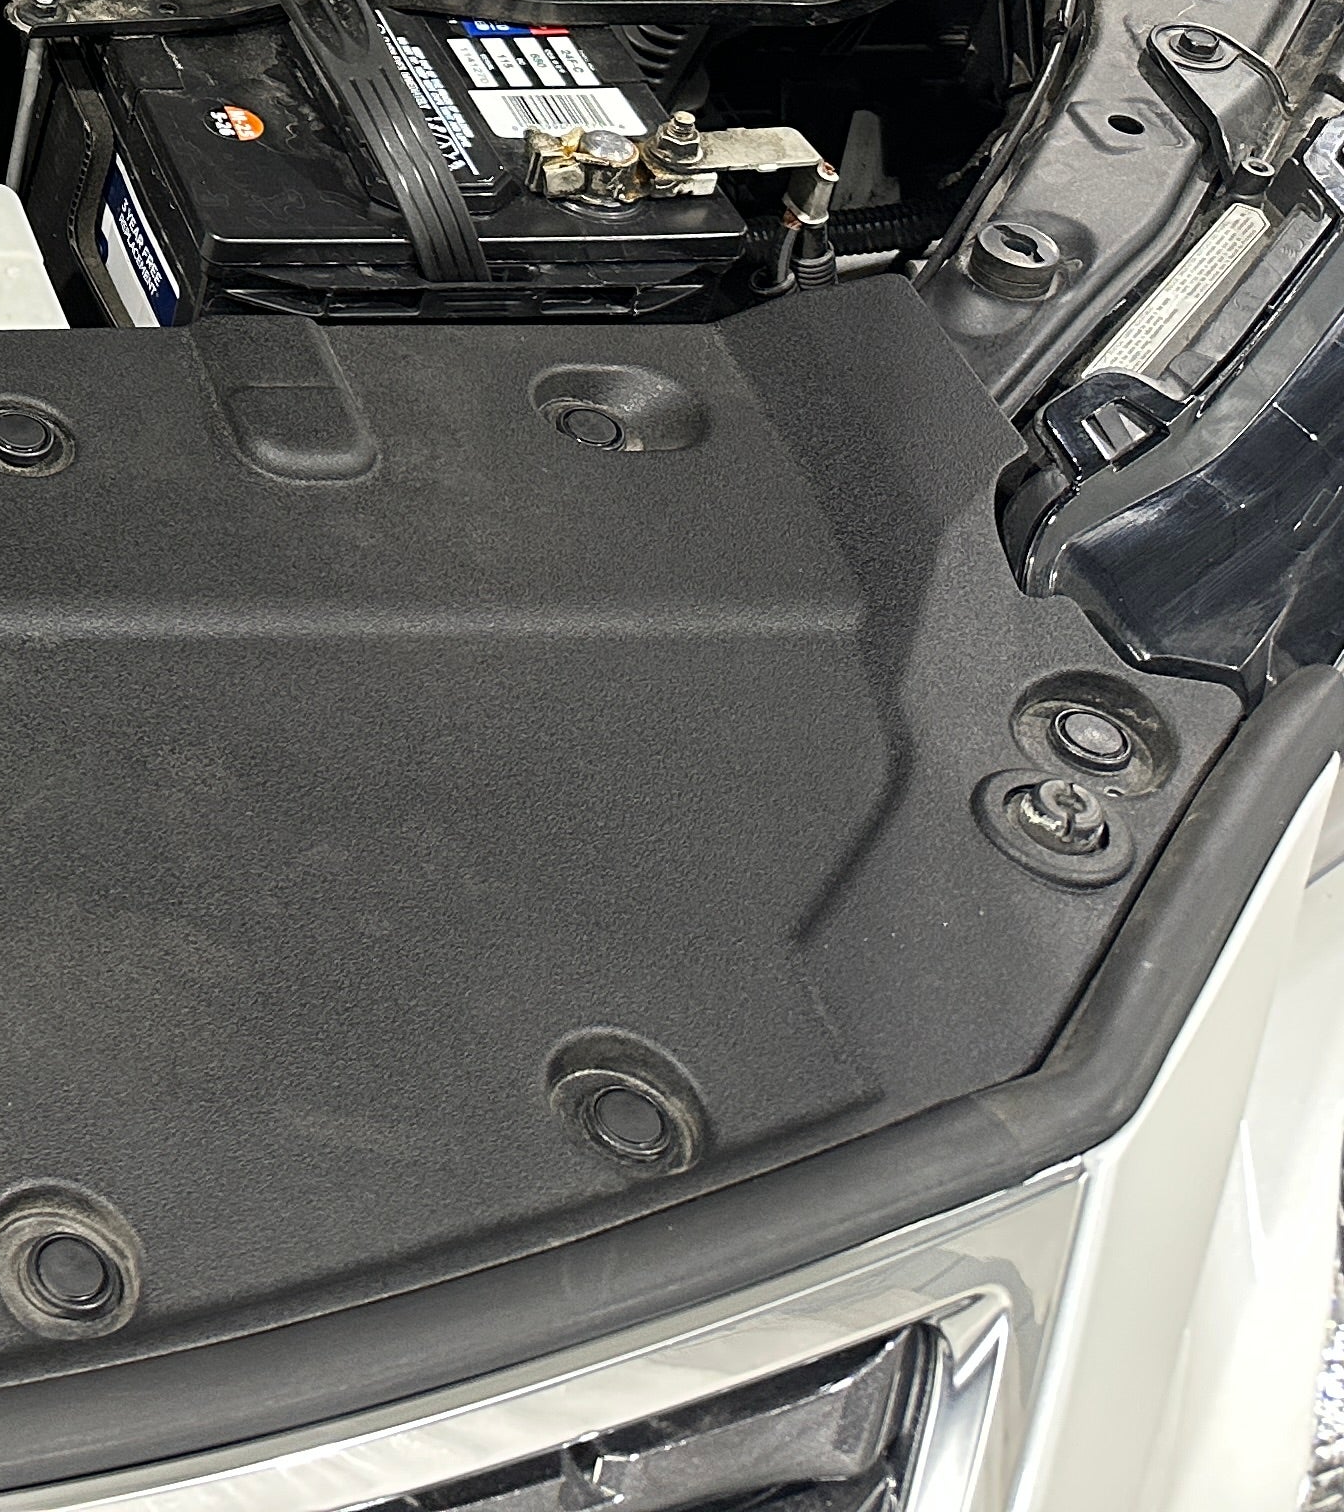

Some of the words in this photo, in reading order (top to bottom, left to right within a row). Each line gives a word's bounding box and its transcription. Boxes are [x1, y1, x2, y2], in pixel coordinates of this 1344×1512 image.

[118, 212, 157, 296] REPLACEMENT
[121, 197, 129, 212] 3
[126, 208, 144, 250] YEAR
[141, 245, 162, 287] FREE
